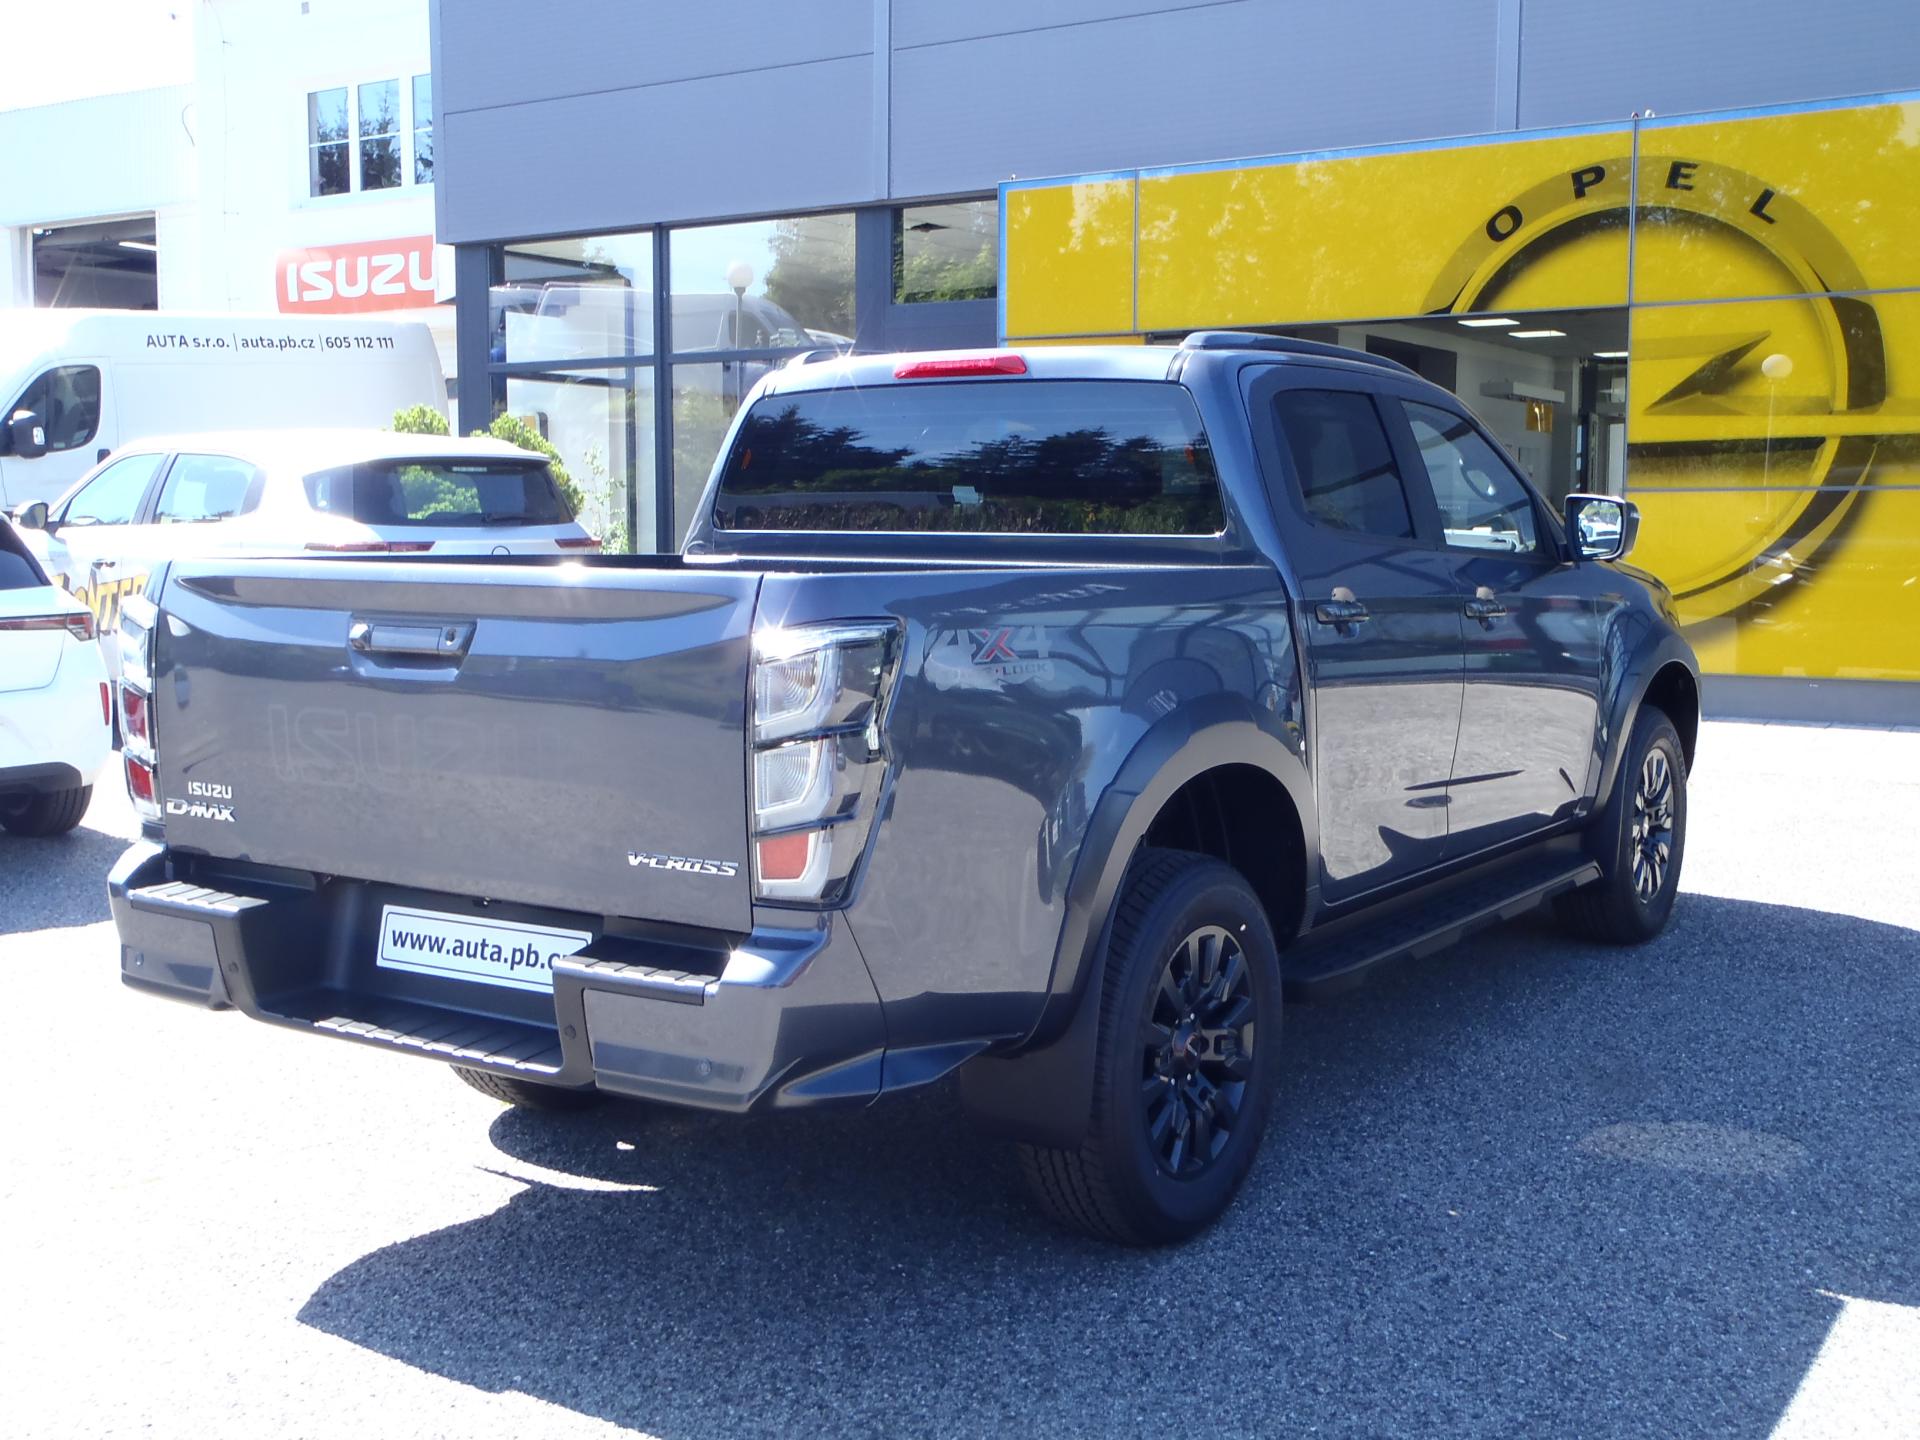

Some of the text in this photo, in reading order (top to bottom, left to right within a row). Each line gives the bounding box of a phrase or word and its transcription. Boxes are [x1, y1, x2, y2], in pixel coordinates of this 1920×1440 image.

[1486, 160, 1778, 242] OPEL
[286, 250, 435, 303] ISUZU
[146, 334, 394, 352] AUTA s.r.o. auta.pb.cz 605 112 111
[188, 781, 232, 799] ISUZU
[166, 798, 236, 822] D-MAX
[627, 851, 739, 877] V-CROSS
[392, 929, 568, 970] www.auta.pb.c
